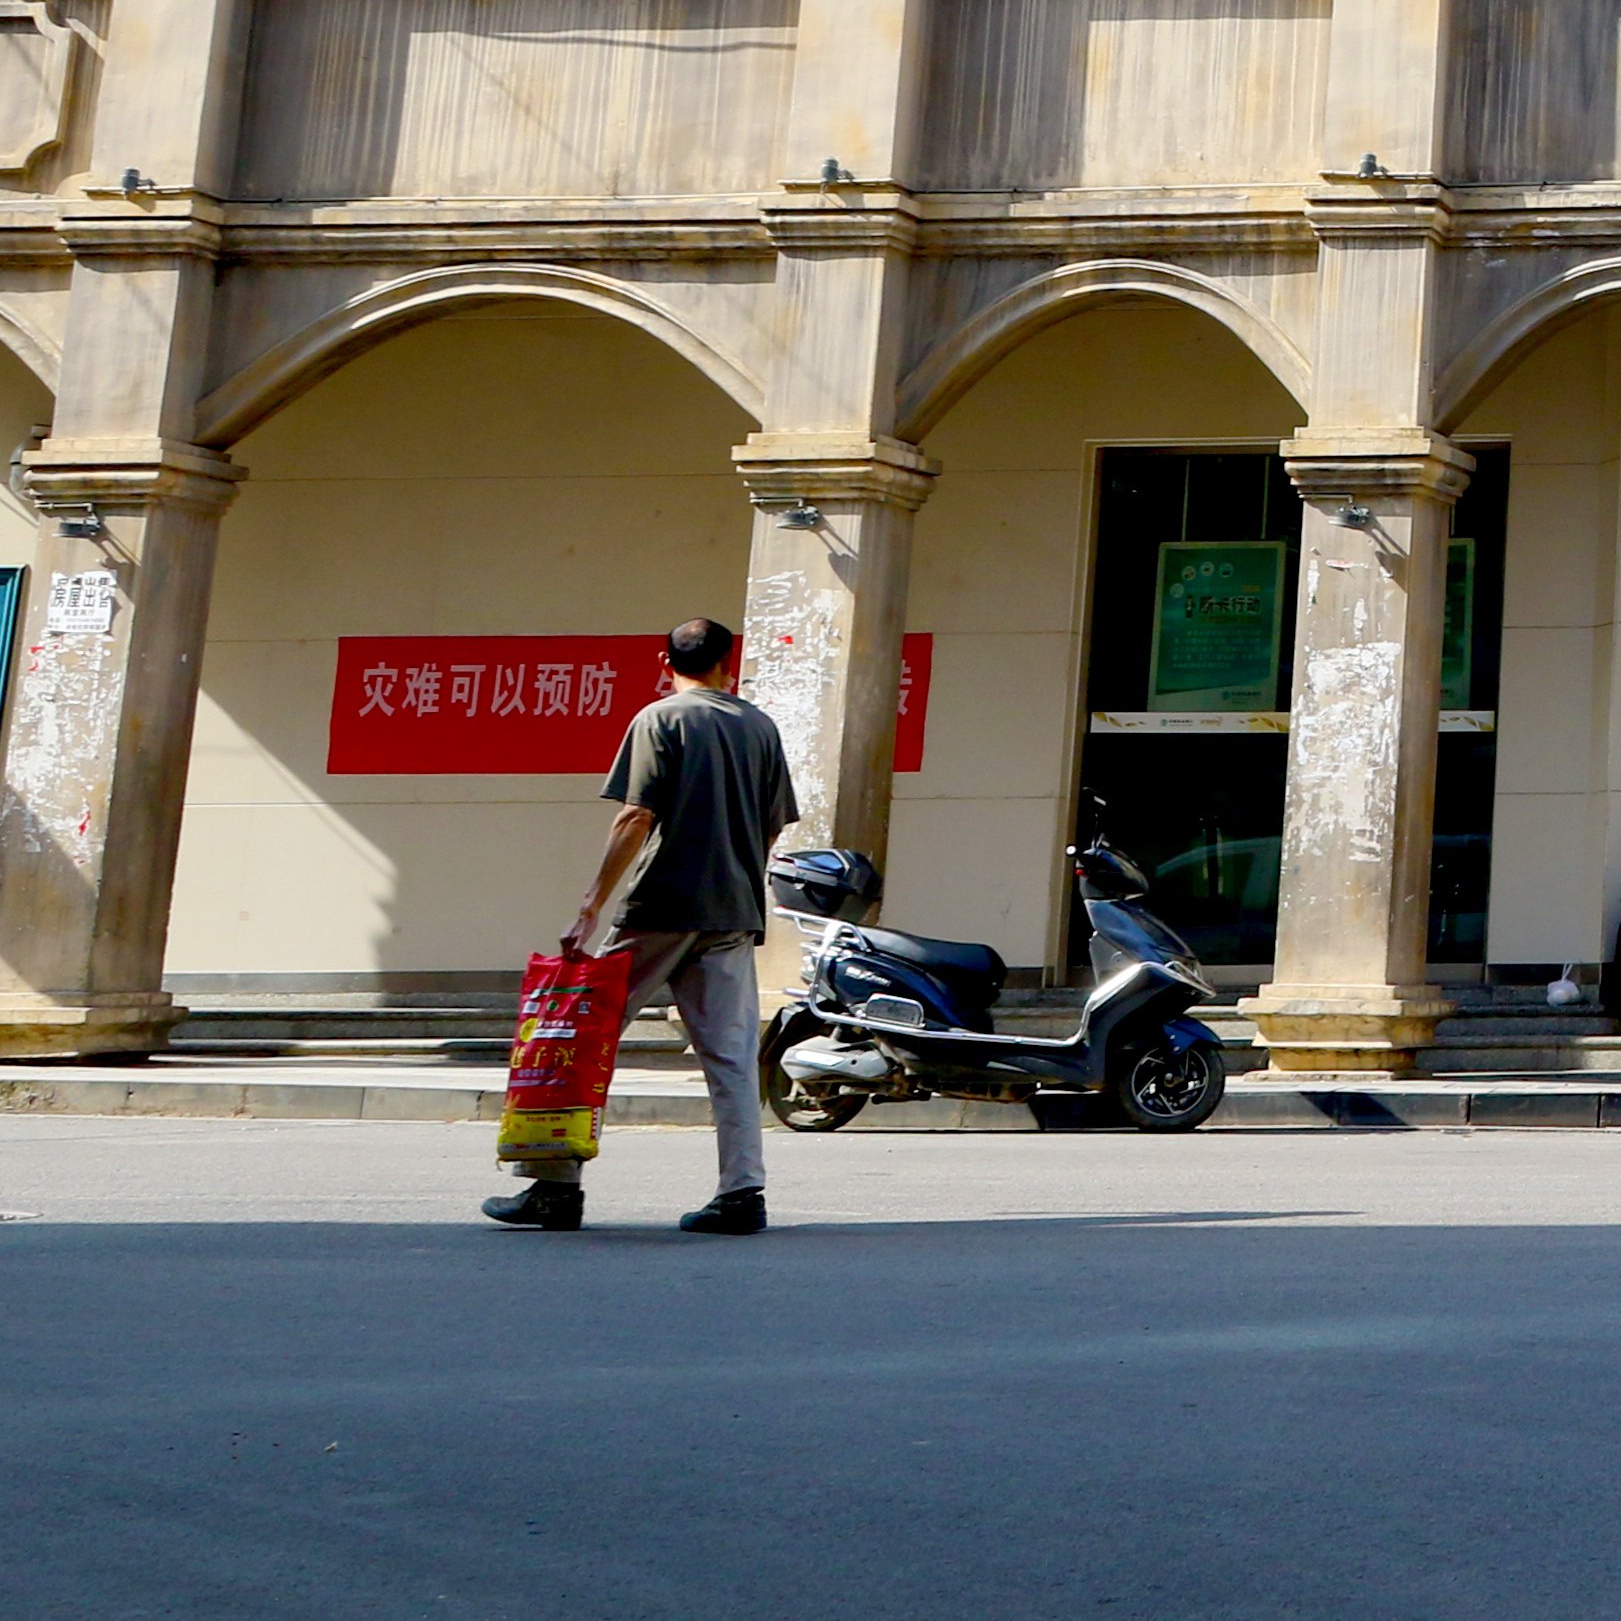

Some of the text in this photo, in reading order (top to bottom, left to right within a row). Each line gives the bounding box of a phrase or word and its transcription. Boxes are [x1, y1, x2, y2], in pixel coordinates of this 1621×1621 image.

[358, 661, 617, 718] 灾难可以预防
